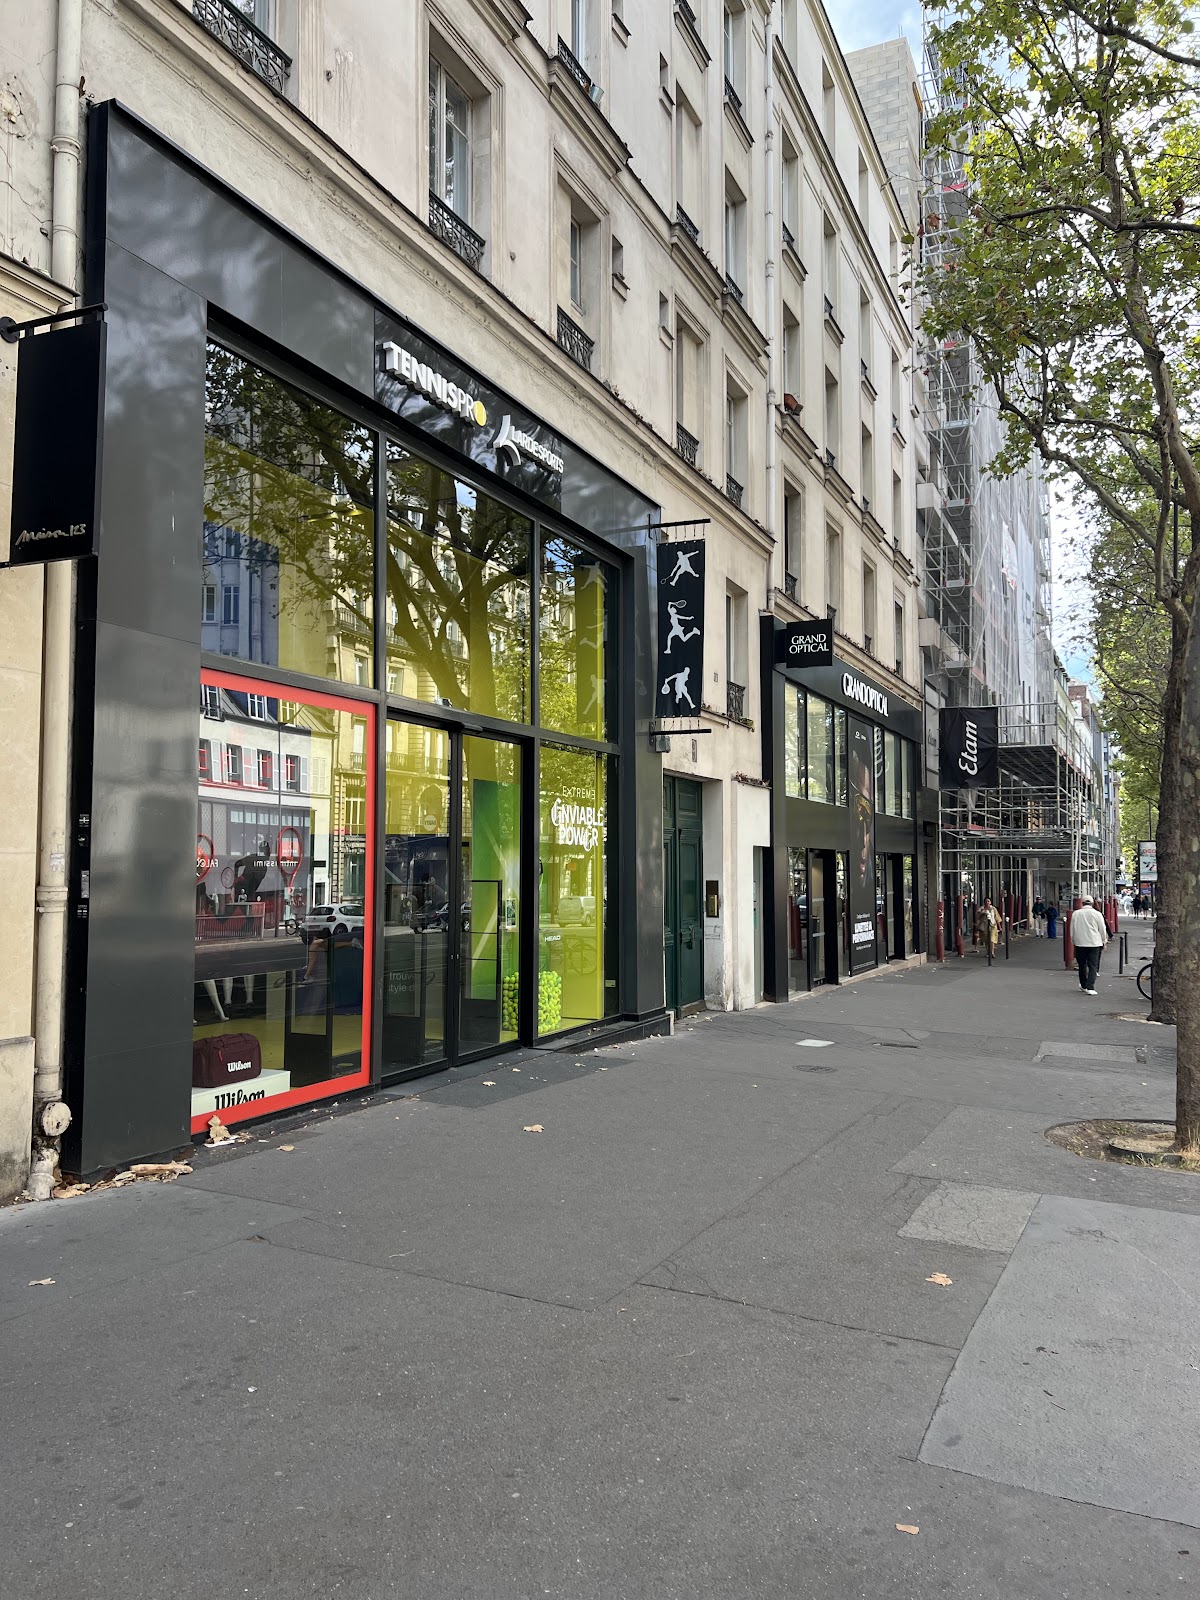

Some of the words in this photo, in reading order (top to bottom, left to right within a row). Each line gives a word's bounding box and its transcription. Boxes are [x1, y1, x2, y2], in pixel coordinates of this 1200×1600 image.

[791, 633, 827, 645] GRAND
[789, 643, 830, 655] OPTICAL
[958, 720, 978, 776] Etam
[559, 824, 599, 852] POWER
[544, 934, 561, 942] HEAD
[227, 1061, 252, 1073] Wilson
